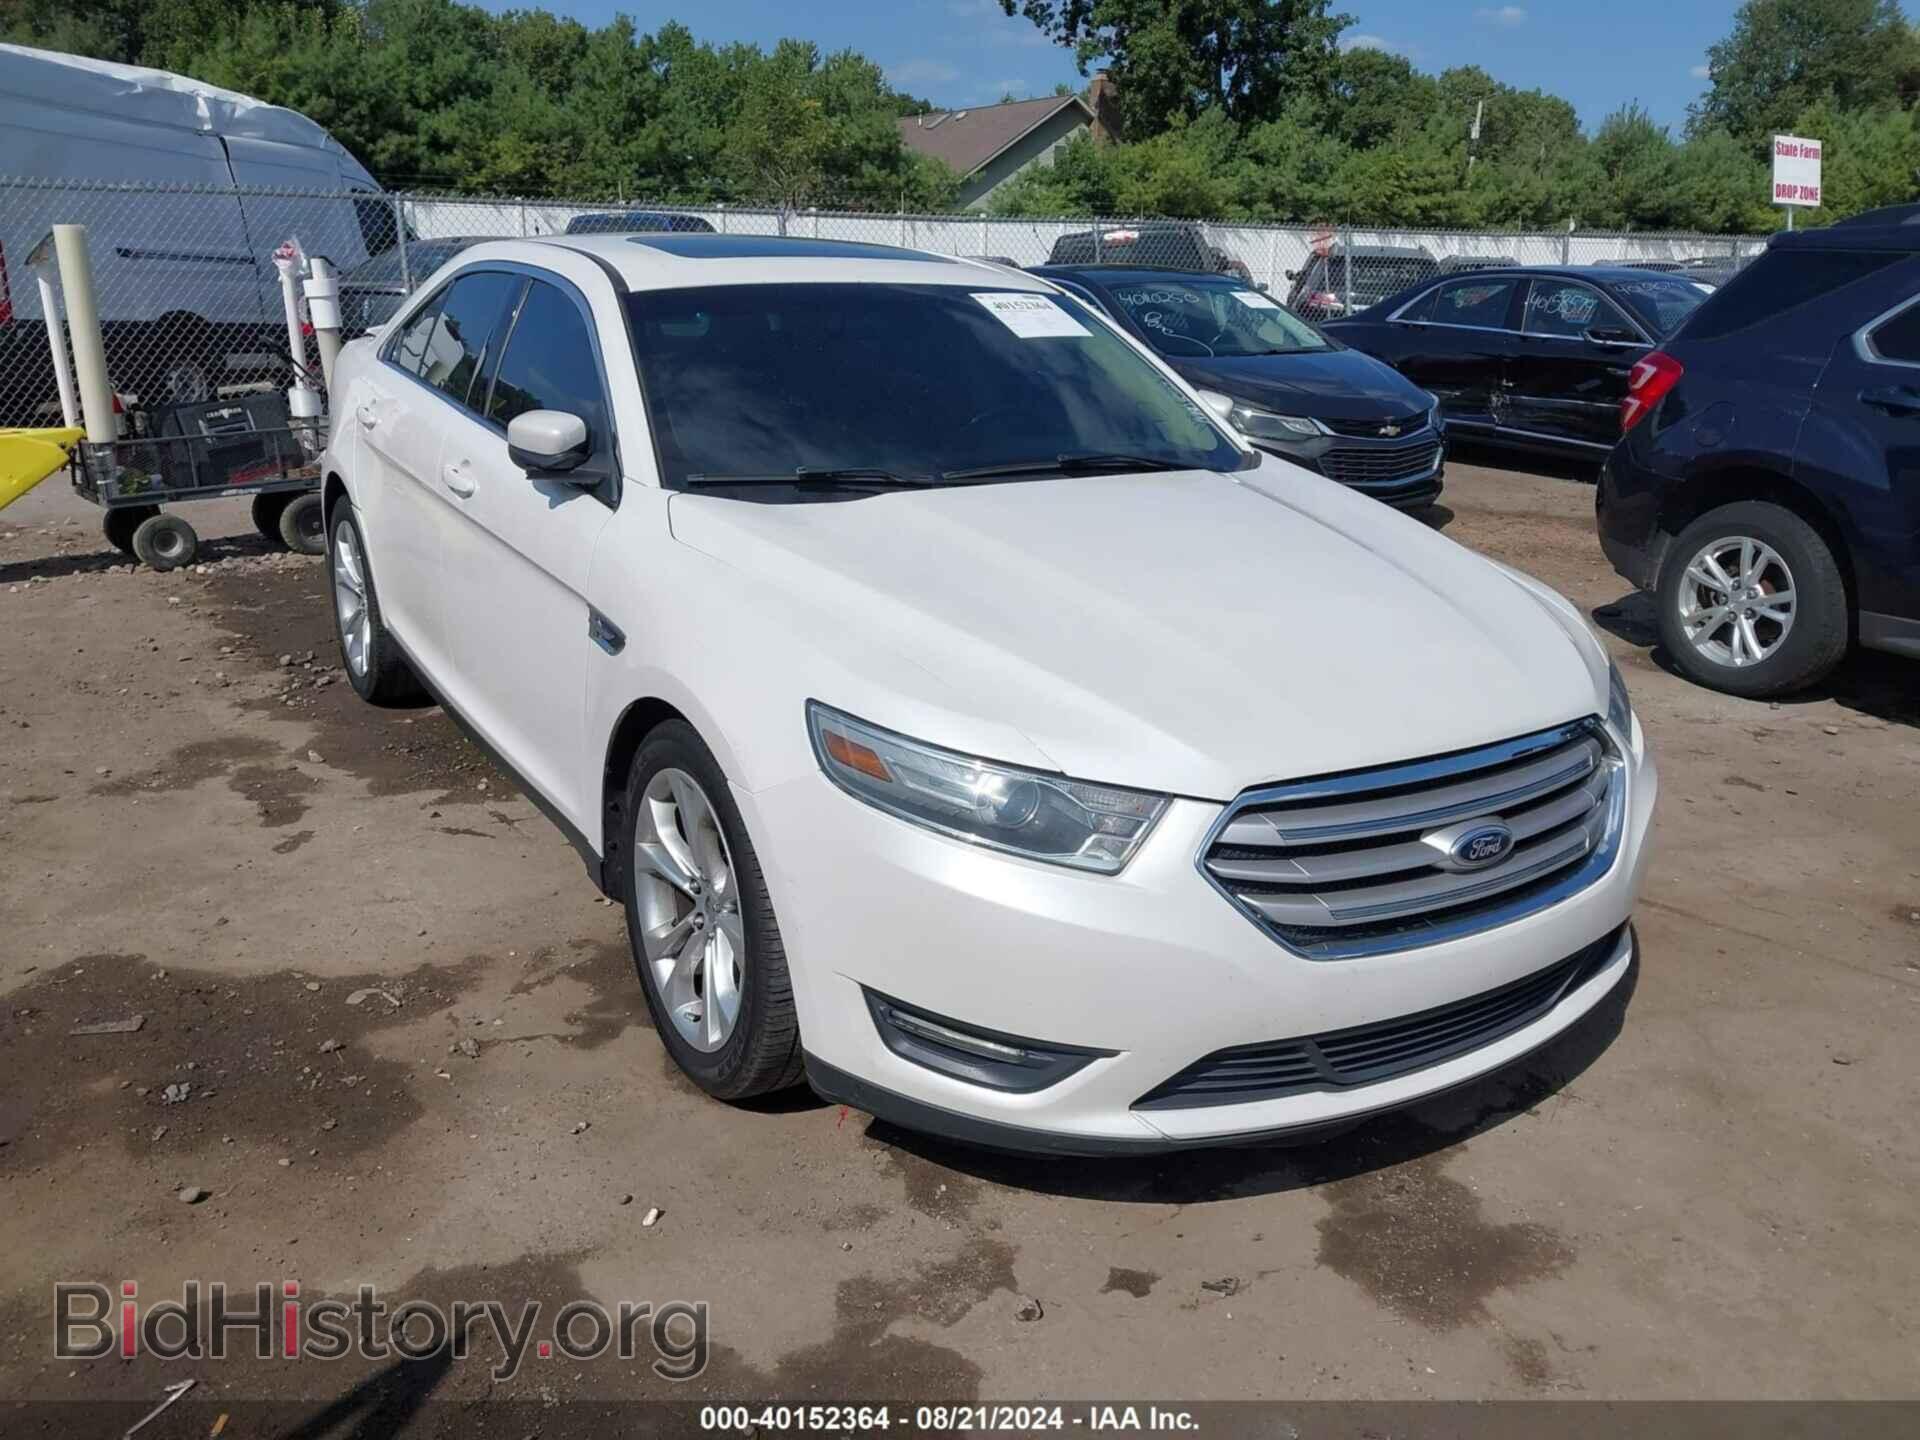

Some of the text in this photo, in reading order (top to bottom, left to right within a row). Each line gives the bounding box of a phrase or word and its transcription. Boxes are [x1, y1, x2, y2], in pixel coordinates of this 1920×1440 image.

[1776, 141, 1820, 160] State Farm
[1776, 183, 1819, 201] DROP ZONE
[1470, 836, 1502, 860] Ford
